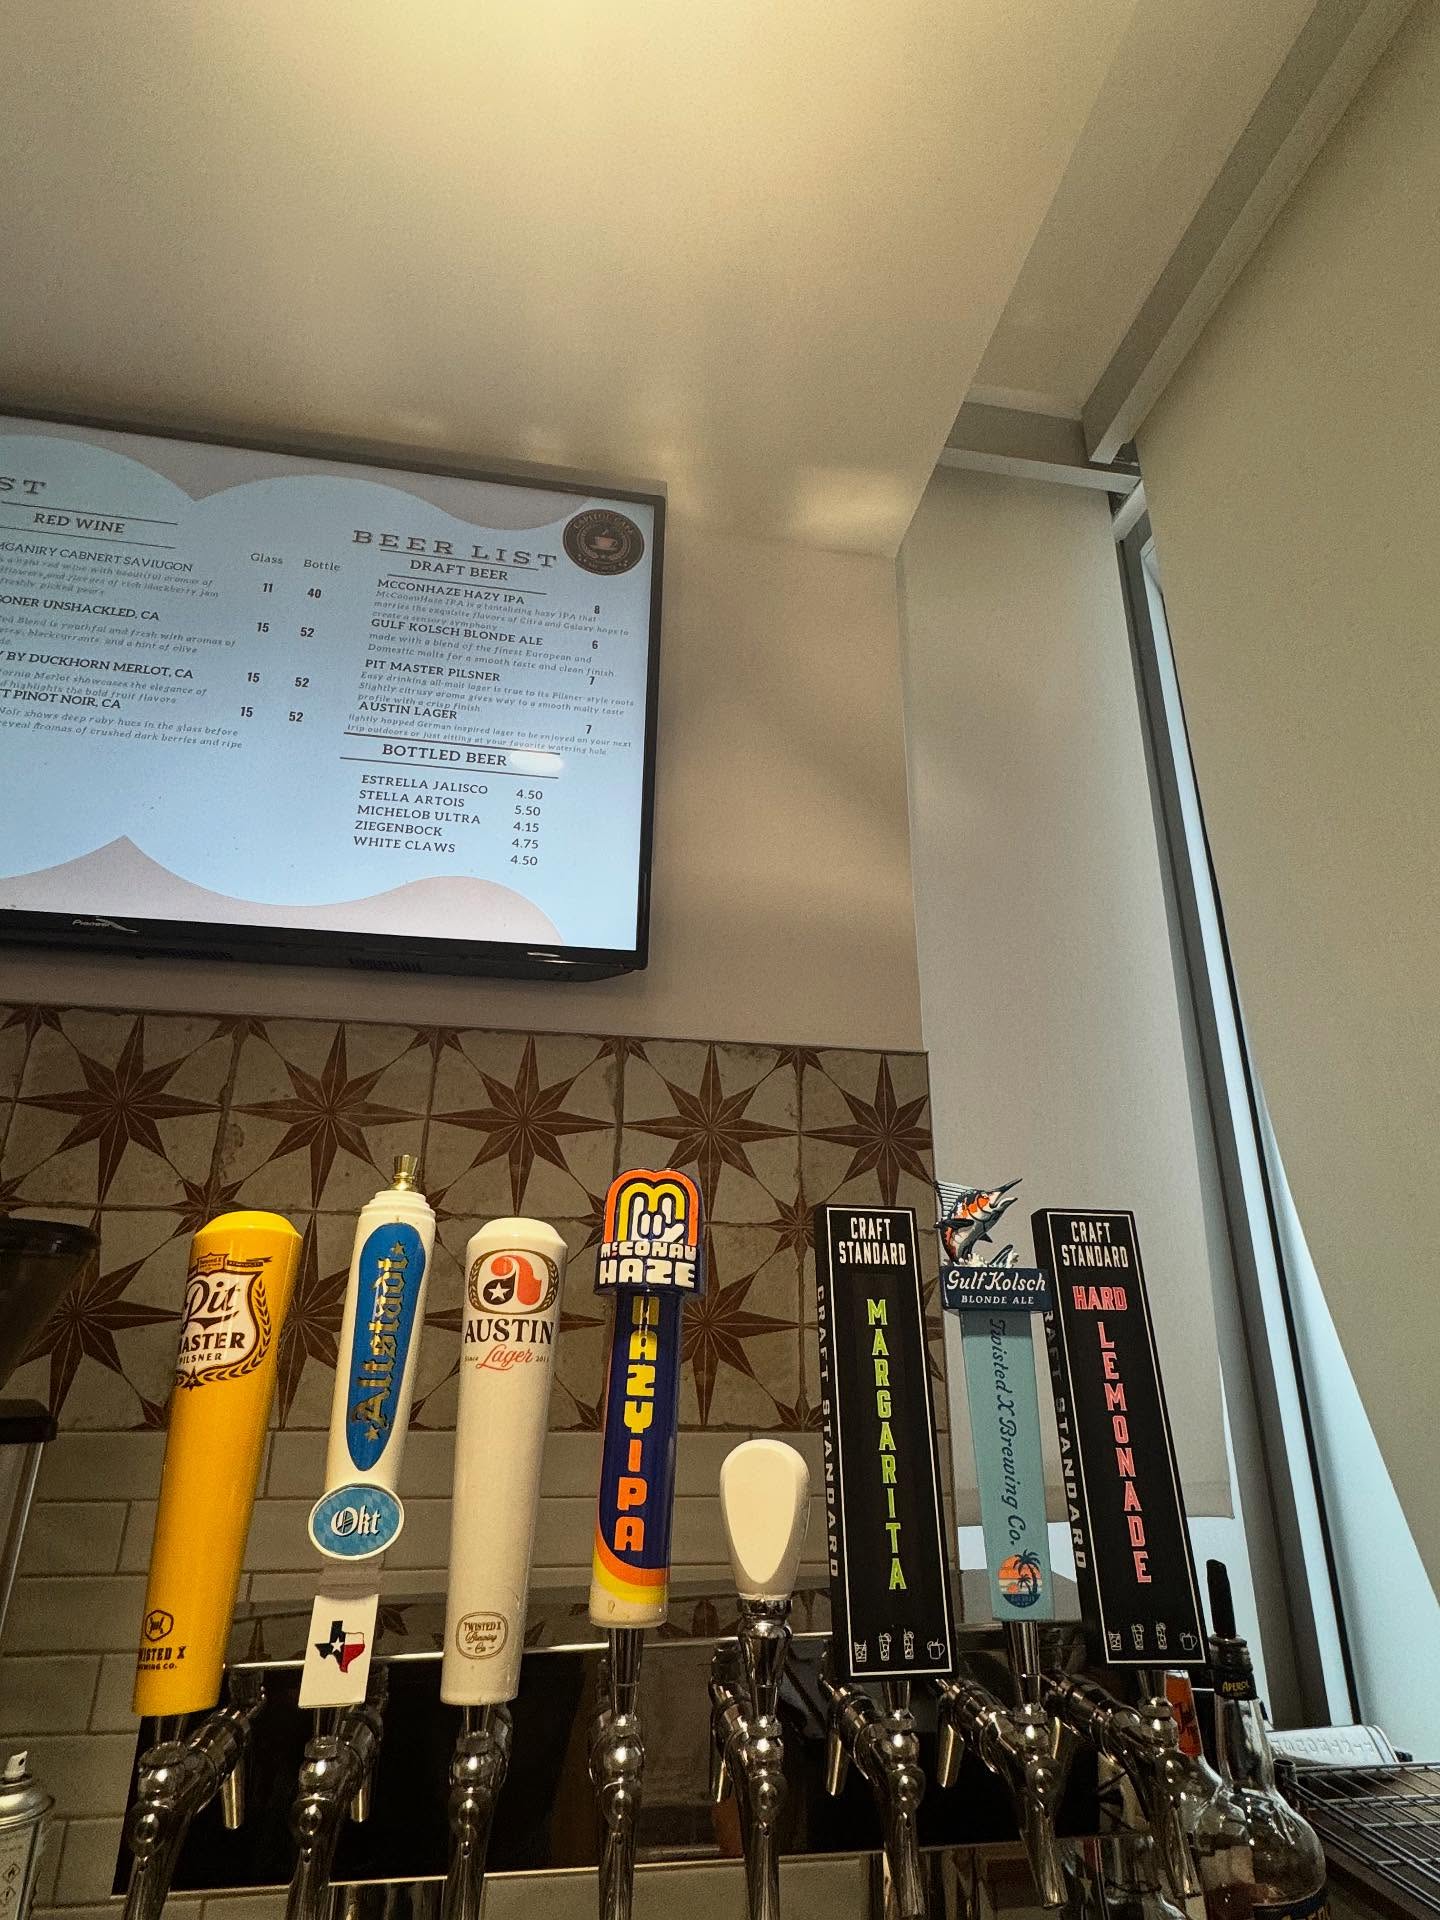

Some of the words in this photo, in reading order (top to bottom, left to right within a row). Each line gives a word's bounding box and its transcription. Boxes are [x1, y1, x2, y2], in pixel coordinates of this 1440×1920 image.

[33, 513, 70, 526] RED
[76, 518, 126, 533] WINE
[352, 530, 454, 555] BEER
[471, 545, 557, 569] LIST
[250, 553, 283, 565] Glass
[304, 559, 341, 571] Bottle
[410, 560, 466, 576] DRAFT
[470, 566, 509, 581] BEER
[263, 583, 273, 593] 11
[308, 588, 322, 598] 40
[377, 579, 461, 597] MCCONHAZE
[464, 589, 500, 601] HAZY
[503, 594, 525, 605] IPA
[141, 610, 160, 621] CA
[594, 605, 600, 615] 8
[257, 622, 270, 633] 15
[300, 627, 315, 638] 52
[371, 618, 406, 630] GULF
[409, 622, 460, 637] KOLSCH
[463, 629, 516, 643] BLONDE
[519, 635, 543, 646] ALE
[563, 622, 593, 633] Galaxy
[369, 632, 395, 642] made
[400, 636, 422, 645] with
[433, 639, 459, 649] blend
[462, 642, 473, 650] of
[476, 644, 491, 652] the
[493, 645, 522, 656] finest
[525, 650, 571, 662] European
[575, 655, 592, 664] and
[592, 640, 599, 650] 6
[6, 651, 29, 662] BY
[29, 653, 111, 671] DUCKHORN
[174, 669, 194, 680] CA
[368, 643, 415, 656] Domestic
[417, 650, 444, 659] malts
[448, 653, 461, 662] for
[474, 658, 510, 667] smooth
[513, 661, 536, 670] taste
[538, 663, 556, 671] and
[559, 665, 584, 674] clean
[247, 672, 261, 683] 15
[295, 677, 310, 688] 52
[365, 658, 387, 669] PIT
[390, 661, 444, 676] MASTER
[448, 668, 501, 682] PILSNER
[360, 672, 382, 682] Easy
[386, 673, 427, 686] drinking
[468, 681, 491, 692] lager
[504, 687, 523, 695] true
[537, 691, 549, 699] its
[590, 676, 596, 686] 7
[13, 689, 59, 703] PINOT
[101, 699, 121, 710] CA
[359, 682, 396, 694] Slightly
[399, 686, 433, 697] citrusy
[435, 688, 465, 699] aroma
[468, 692, 493, 703] gives
[496, 697, 515, 706] way
[538, 702, 571, 711] smooth
[573, 704, 599, 715] malty
[602, 708, 625, 716] taste
[61, 711, 87, 723] deep
[240, 706, 254, 718] 15
[289, 711, 304, 722] 52
[358, 701, 410, 714] AUSTIN
[414, 707, 457, 719] LAGER
[586, 724, 592, 734] 7
[382, 744, 461, 761] BOTTLED
[466, 752, 508, 767] BEER
[361, 774, 429, 790] ESTRELLA
[432, 780, 488, 795] JALISCO
[516, 789, 543, 800] 4.50
[359, 790, 410, 803] STELLA
[414, 795, 465, 808] ARTOIS
[357, 805, 431, 820] MICHELOB
[434, 811, 481, 825] ULTRA
[514, 805, 541, 816] 5.50
[355, 820, 443, 837] ZIEGENBOCK
[513, 822, 540, 833] 4.15
[353, 836, 402, 849] WHITE
[404, 840, 456, 853] CLAWS
[512, 838, 539, 849] 4.75
[510, 855, 538, 866] 4.50
[850, 1217, 891, 1241] CRAFT
[1071, 1221, 1111, 1244] CRAFT
[838, 1241, 907, 1266] STANDARD
[1061, 1244, 1129, 1268] STANDARD
[599, 1258, 696, 1288] HAZE
[946, 1270, 986, 1290] Gulf
[985, 1270, 1046, 1291] Kolsch
[961, 1295, 1008, 1305] BLONDE
[1012, 1296, 1035, 1305] ALE
[1072, 1285, 1128, 1311] HARD
[464, 1318, 554, 1345] AUSTIN
[816, 1284, 829, 1384] CRAFT
[180, 1332, 245, 1353] ASTER
[475, 1344, 534, 1371] Lager
[989, 1318, 1012, 1394] Twisted
[996, 1396, 1015, 1418] X
[866, 1298, 907, 1590] MARGARITA
[1044, 1311, 1061, 1376] RAFT
[1056, 1397, 1087, 1569] STANDARD
[1097, 1321, 1152, 1584] LEMONADE
[998, 1416, 1018, 1512] Brewing
[613, 1439, 648, 1552] IPA
[822, 1399, 839, 1577] STANDARD
[330, 1504, 381, 1536] Okt
[1007, 1514, 1026, 1547] Co.
[177, 1646, 186, 1659] X
